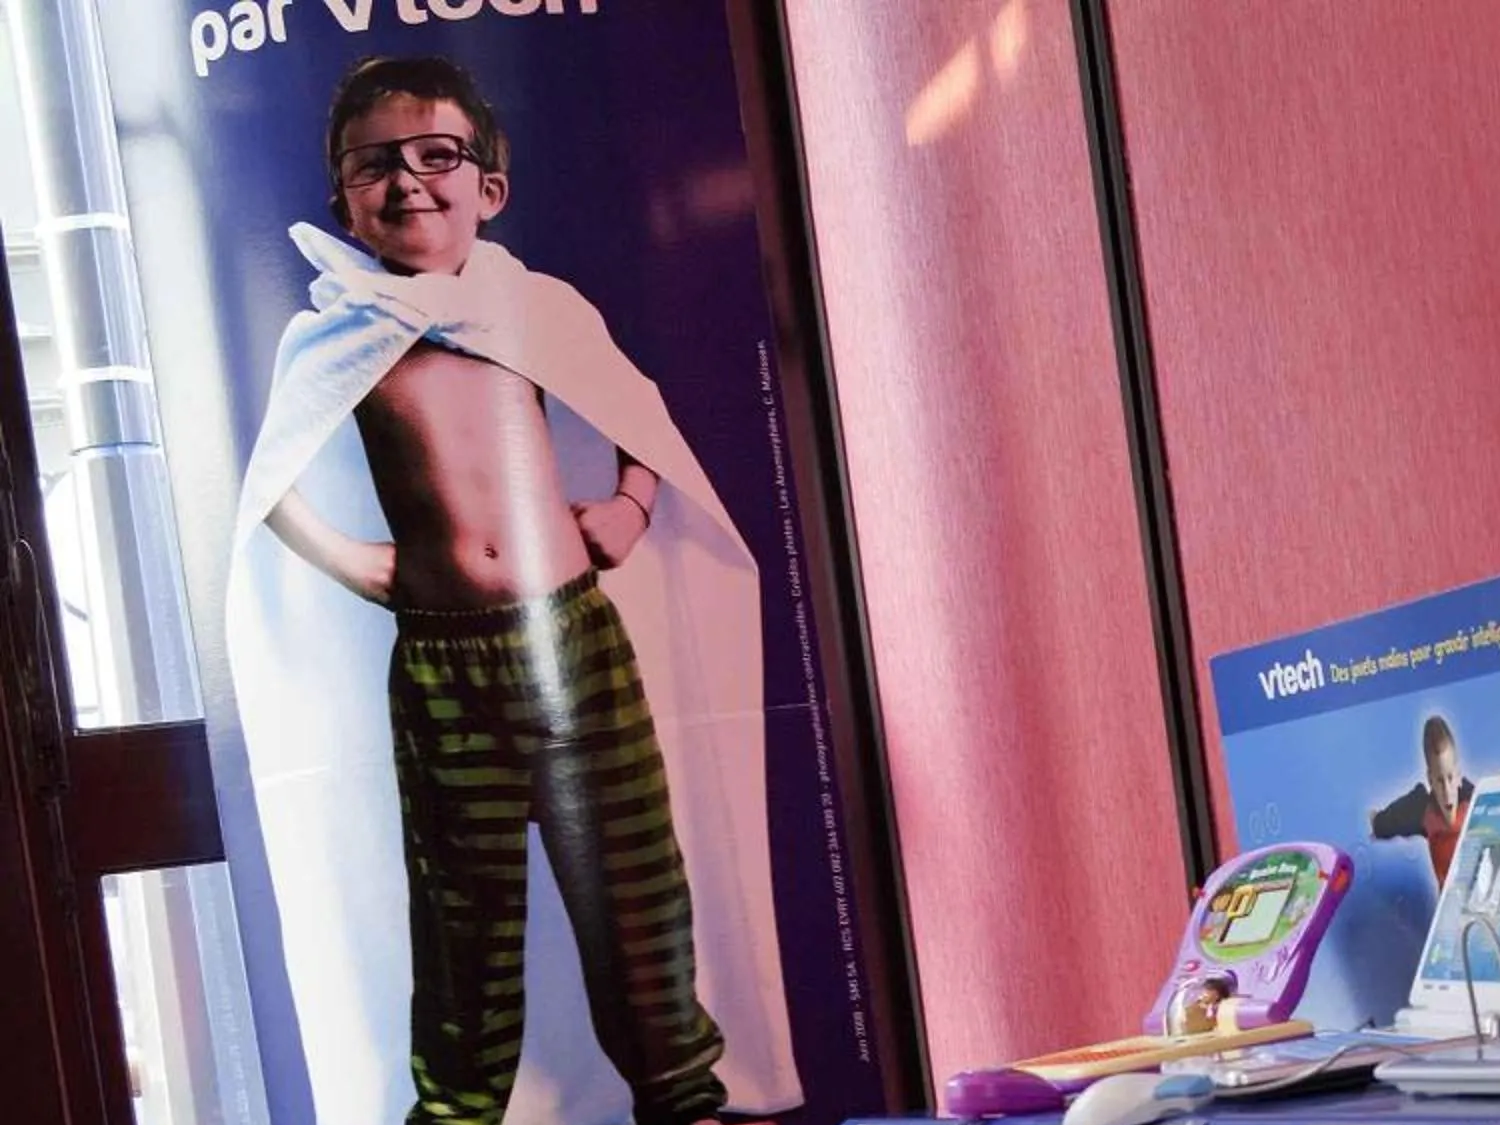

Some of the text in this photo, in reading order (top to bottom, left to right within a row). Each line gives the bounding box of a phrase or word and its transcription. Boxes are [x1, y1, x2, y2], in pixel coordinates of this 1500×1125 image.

[190, 0, 292, 76] par
[1258, 648, 1326, 700] vtech
[1329, 663, 1350, 684] Des
